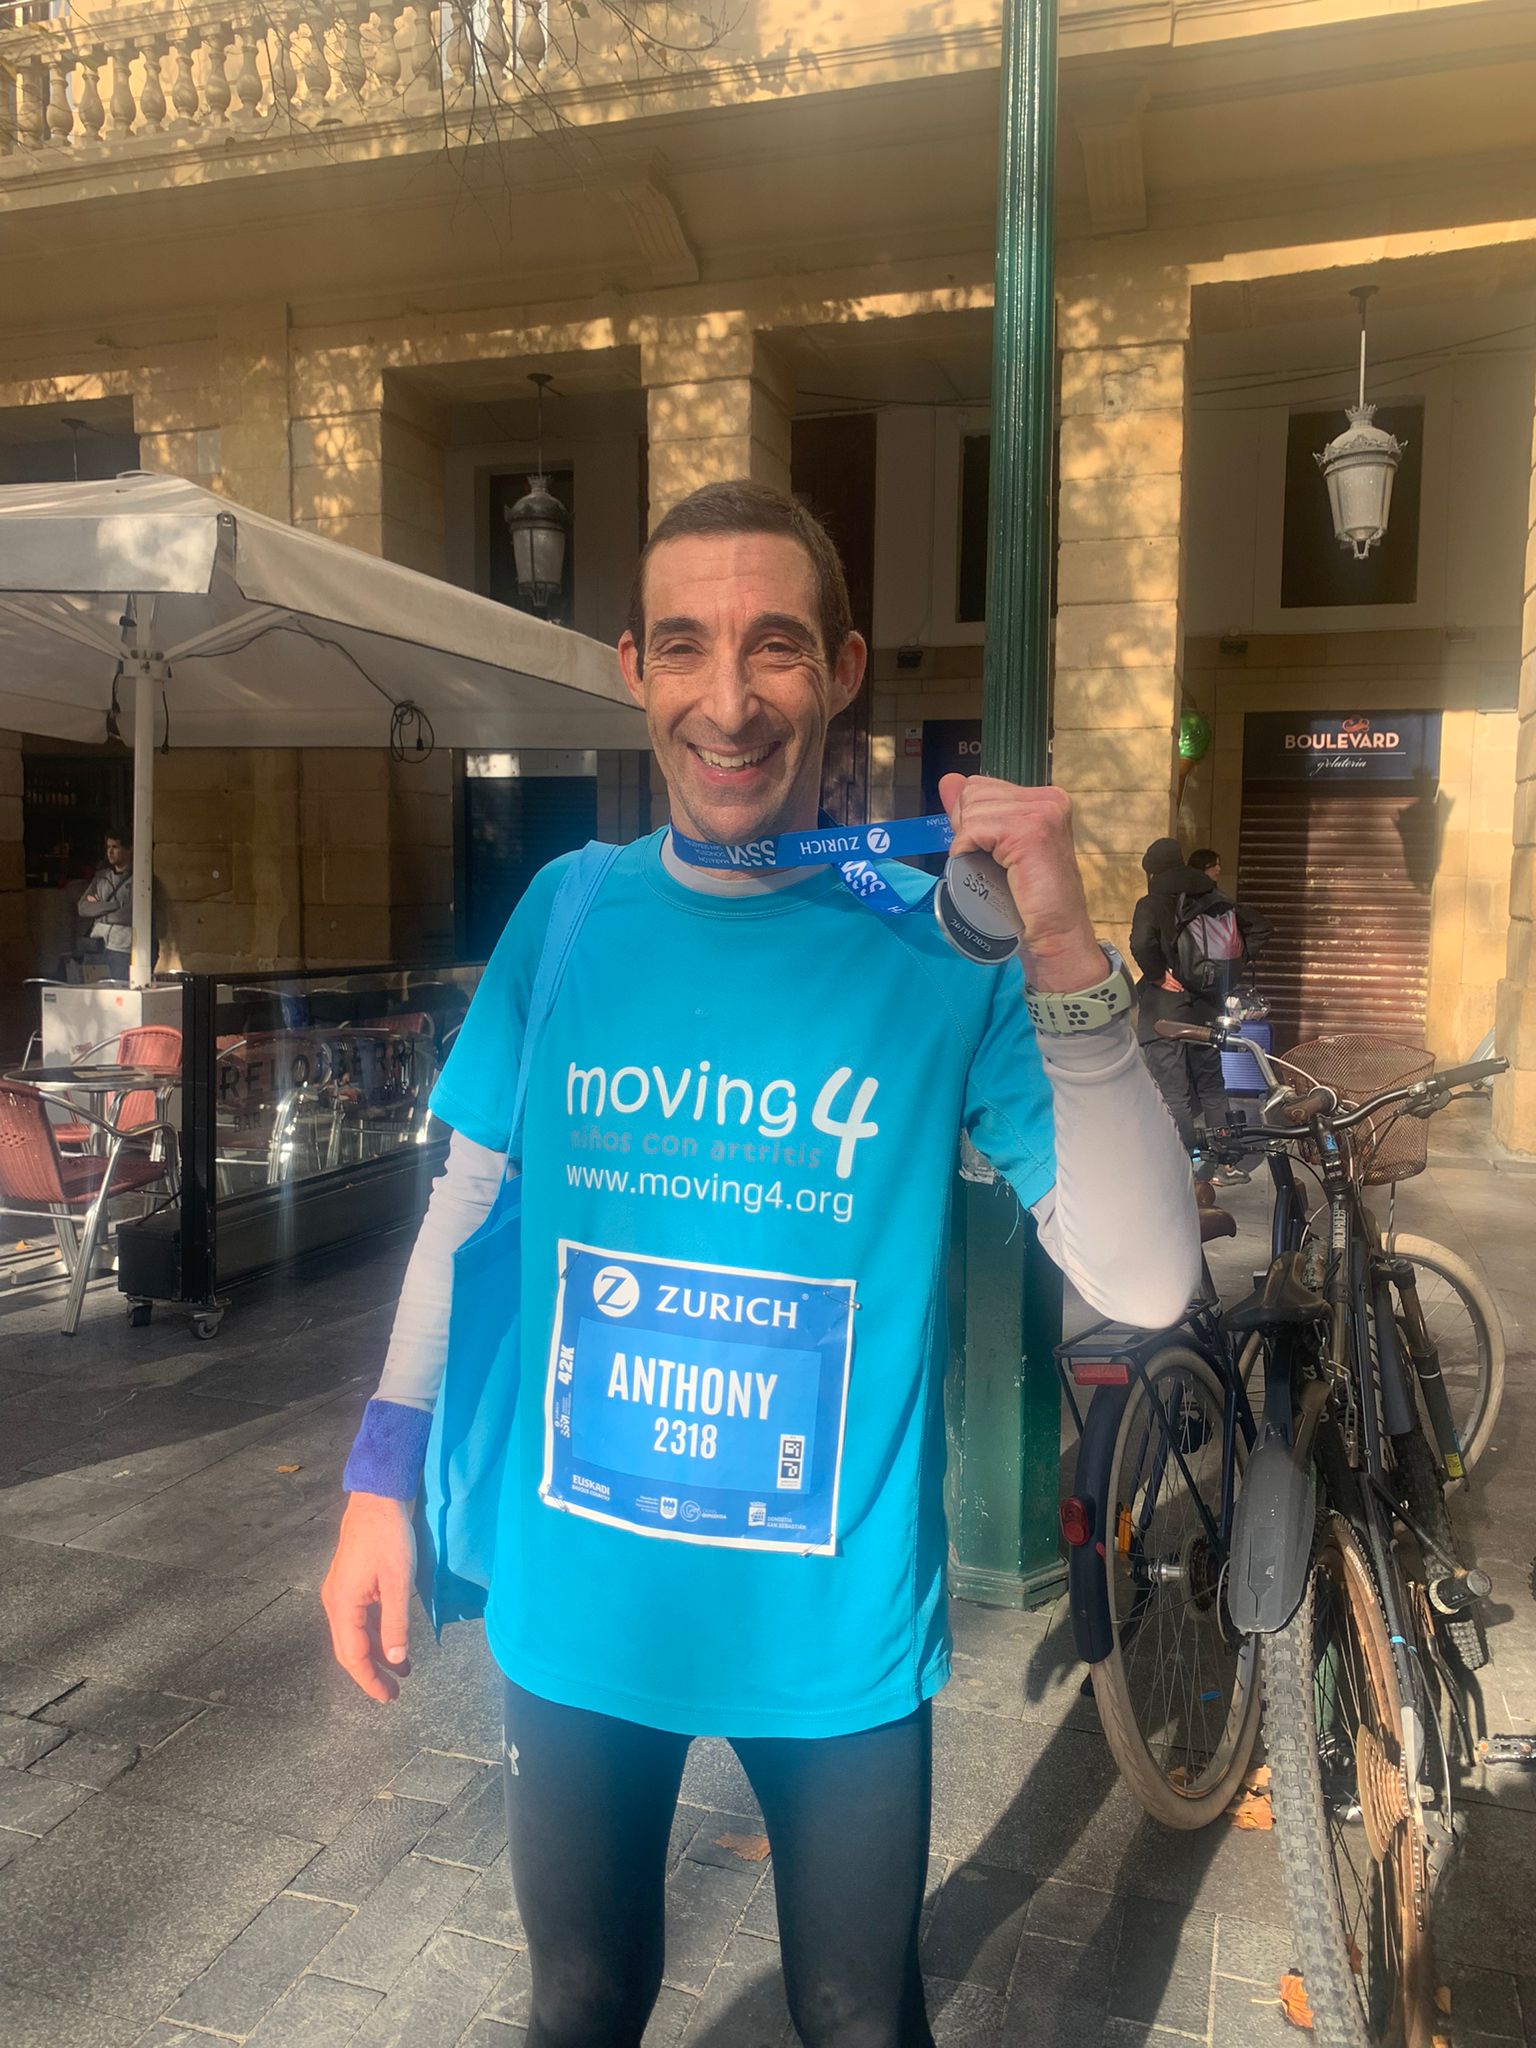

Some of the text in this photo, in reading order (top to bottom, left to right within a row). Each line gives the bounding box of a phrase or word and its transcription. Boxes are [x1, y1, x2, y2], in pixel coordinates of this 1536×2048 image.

[1285, 732, 1400, 750] BOULEVARD
[1309, 755, 1367, 777] gelateria
[800, 836, 860, 855] ZURICH
[566, 1060, 879, 1179] moving 4
[570, 1125, 822, 1169] niños con artritis
[566, 1164, 853, 1223] www.moving4.org
[655, 1285, 799, 1329] ZURICH
[558, 1344, 575, 1386] 42K
[607, 1352, 778, 1421] ANTHONY
[653, 1417, 718, 1459] 2318
[572, 1474, 610, 1496] EUSKADI
